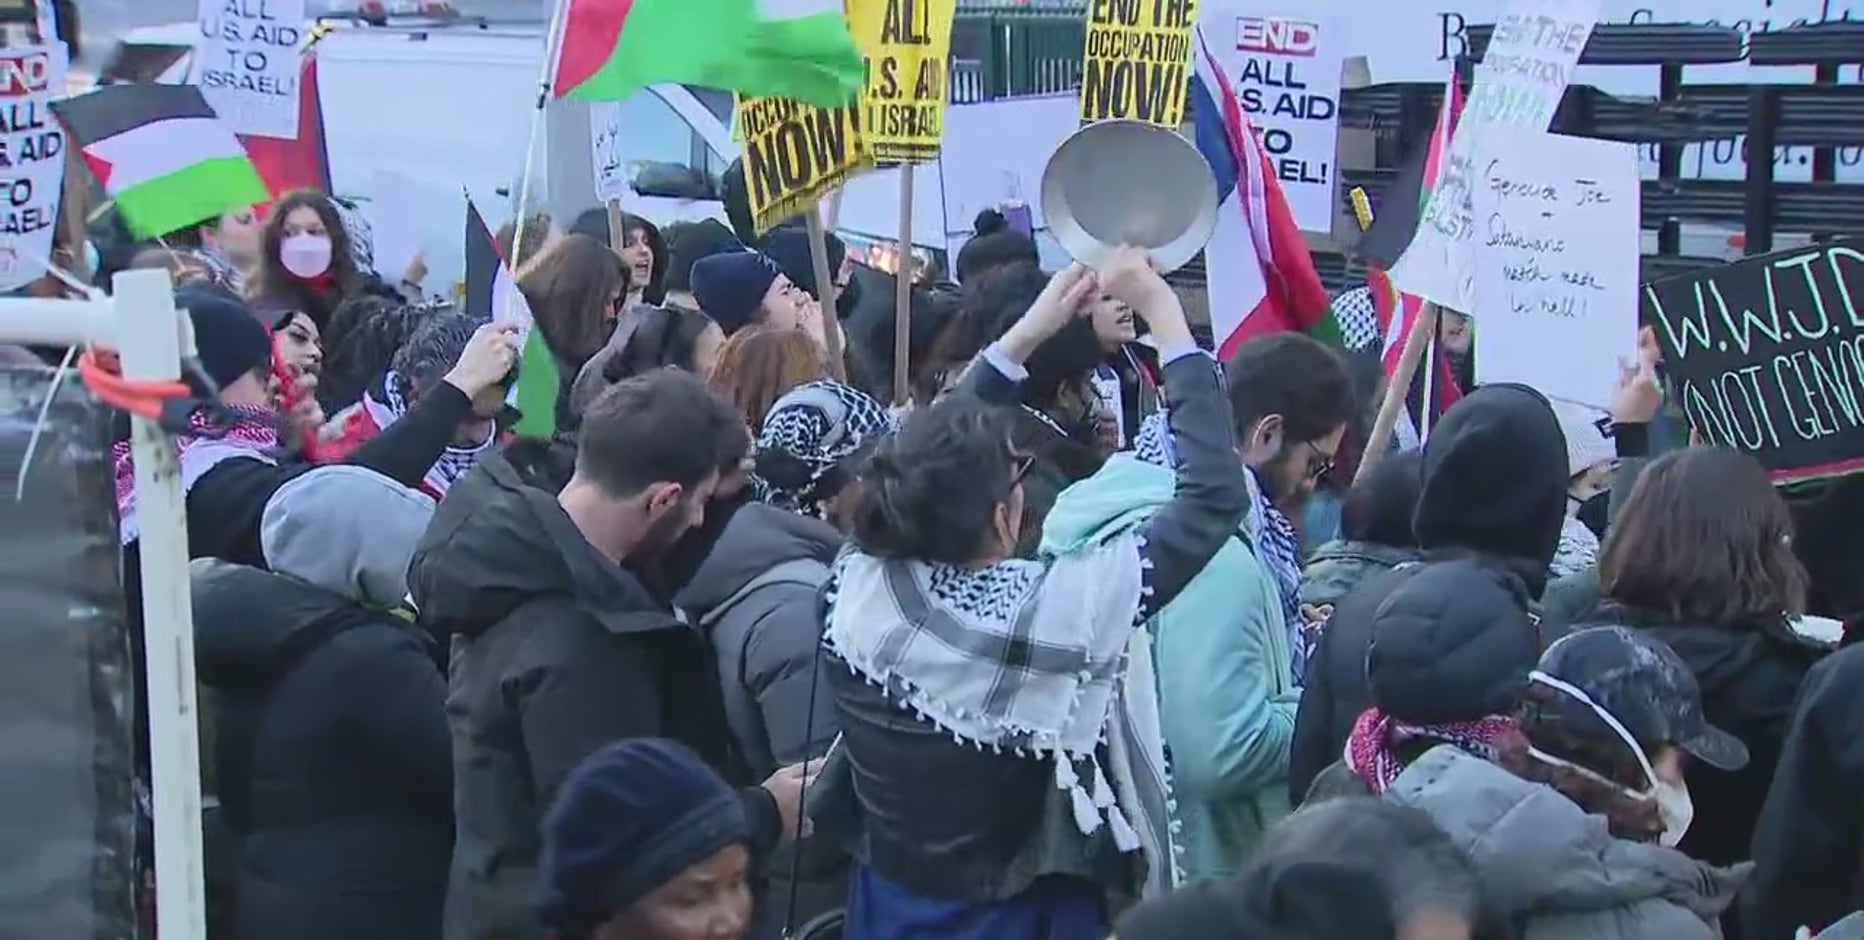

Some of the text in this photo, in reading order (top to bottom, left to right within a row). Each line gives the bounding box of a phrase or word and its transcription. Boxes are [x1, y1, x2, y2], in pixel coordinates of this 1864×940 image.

[224, 0, 277, 21] ALL
[1093, 0, 1195, 28] END THE
[250, 25, 299, 47] AID
[1088, 30, 1189, 63] OCCUPATION
[1237, 18, 1319, 55] END
[0, 52, 47, 94] ND
[226, 49, 267, 72] TO
[1241, 58, 1306, 89] ALL
[1084, 60, 1185, 124] NOW!
[1272, 93, 1335, 120] AID
[20, 131, 62, 164] AID
[748, 95, 863, 210] NOW!
